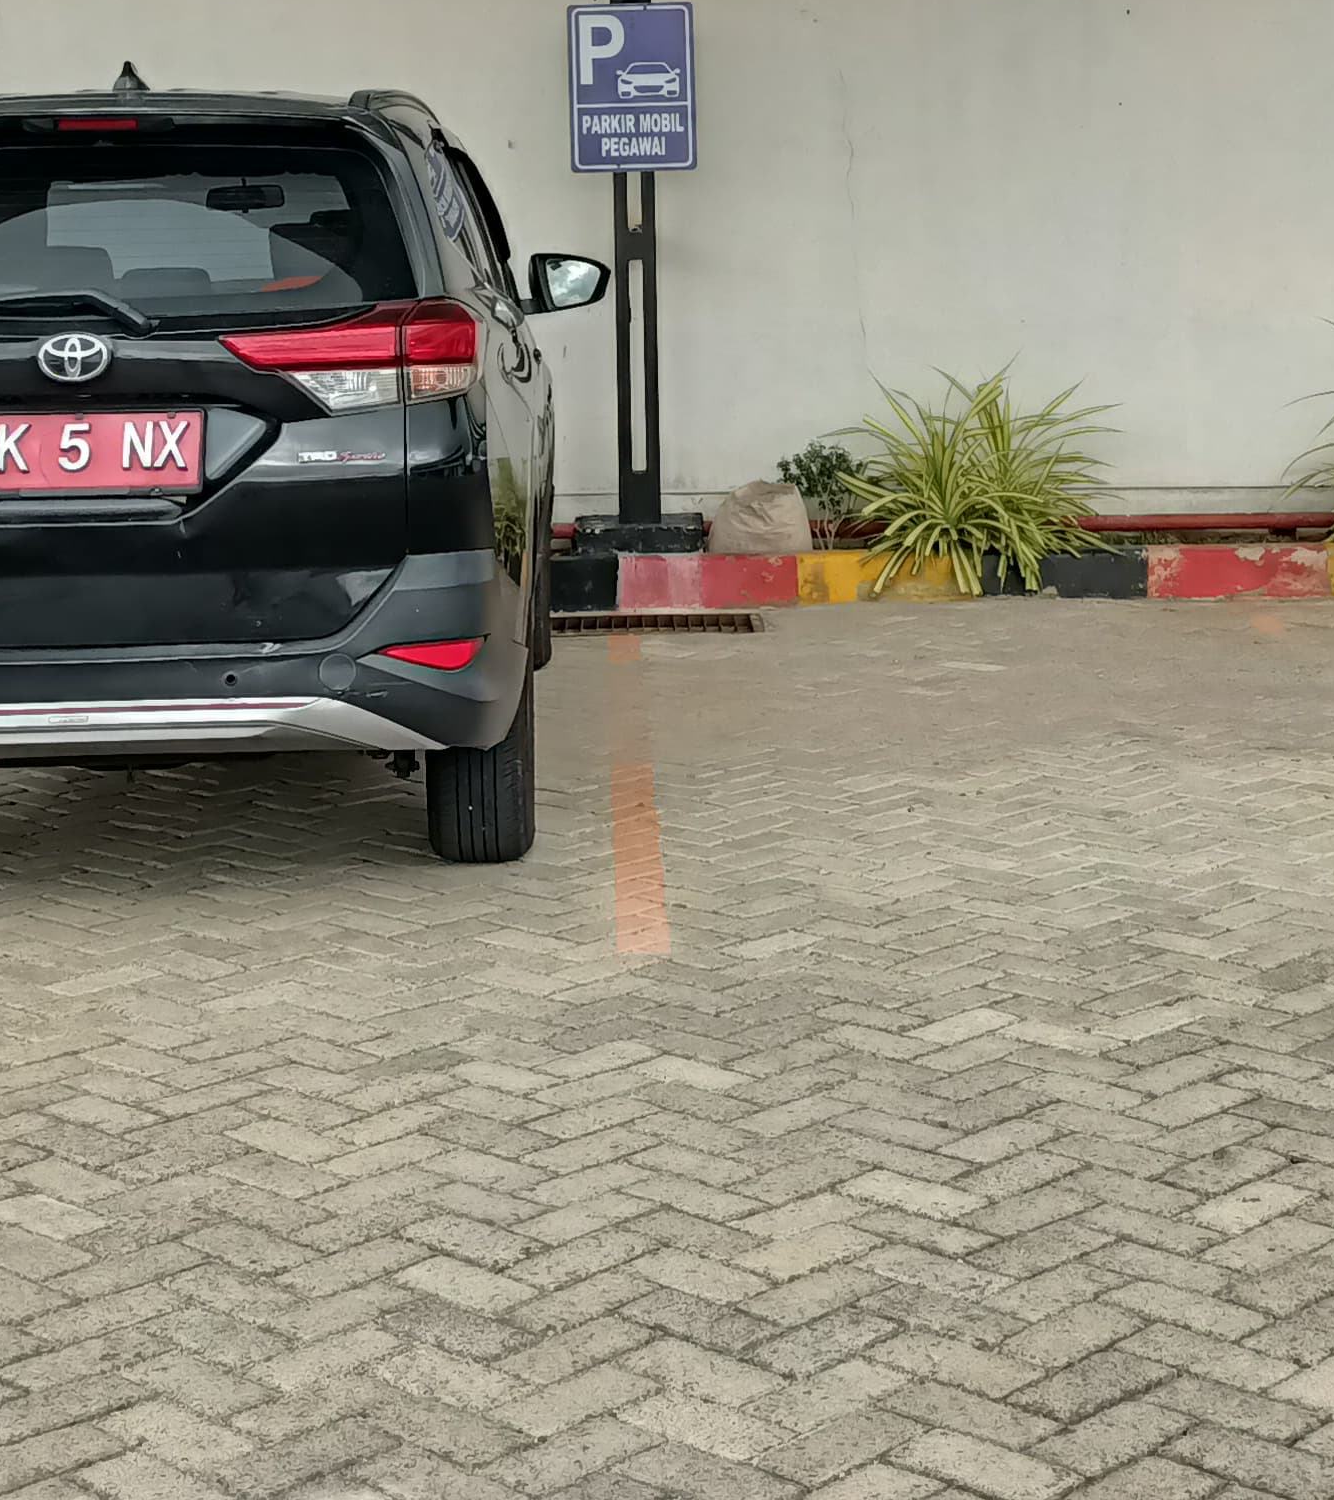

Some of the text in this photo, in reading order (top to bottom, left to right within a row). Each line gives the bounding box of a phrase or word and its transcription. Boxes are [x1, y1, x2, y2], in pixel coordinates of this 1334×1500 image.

[578, 14, 625, 85] P
[582, 112, 685, 135] PARKIR MOBIL
[601, 136, 666, 158] PEGAWAI
[58, 422, 91, 472] 5
[122, 420, 189, 470] NX
